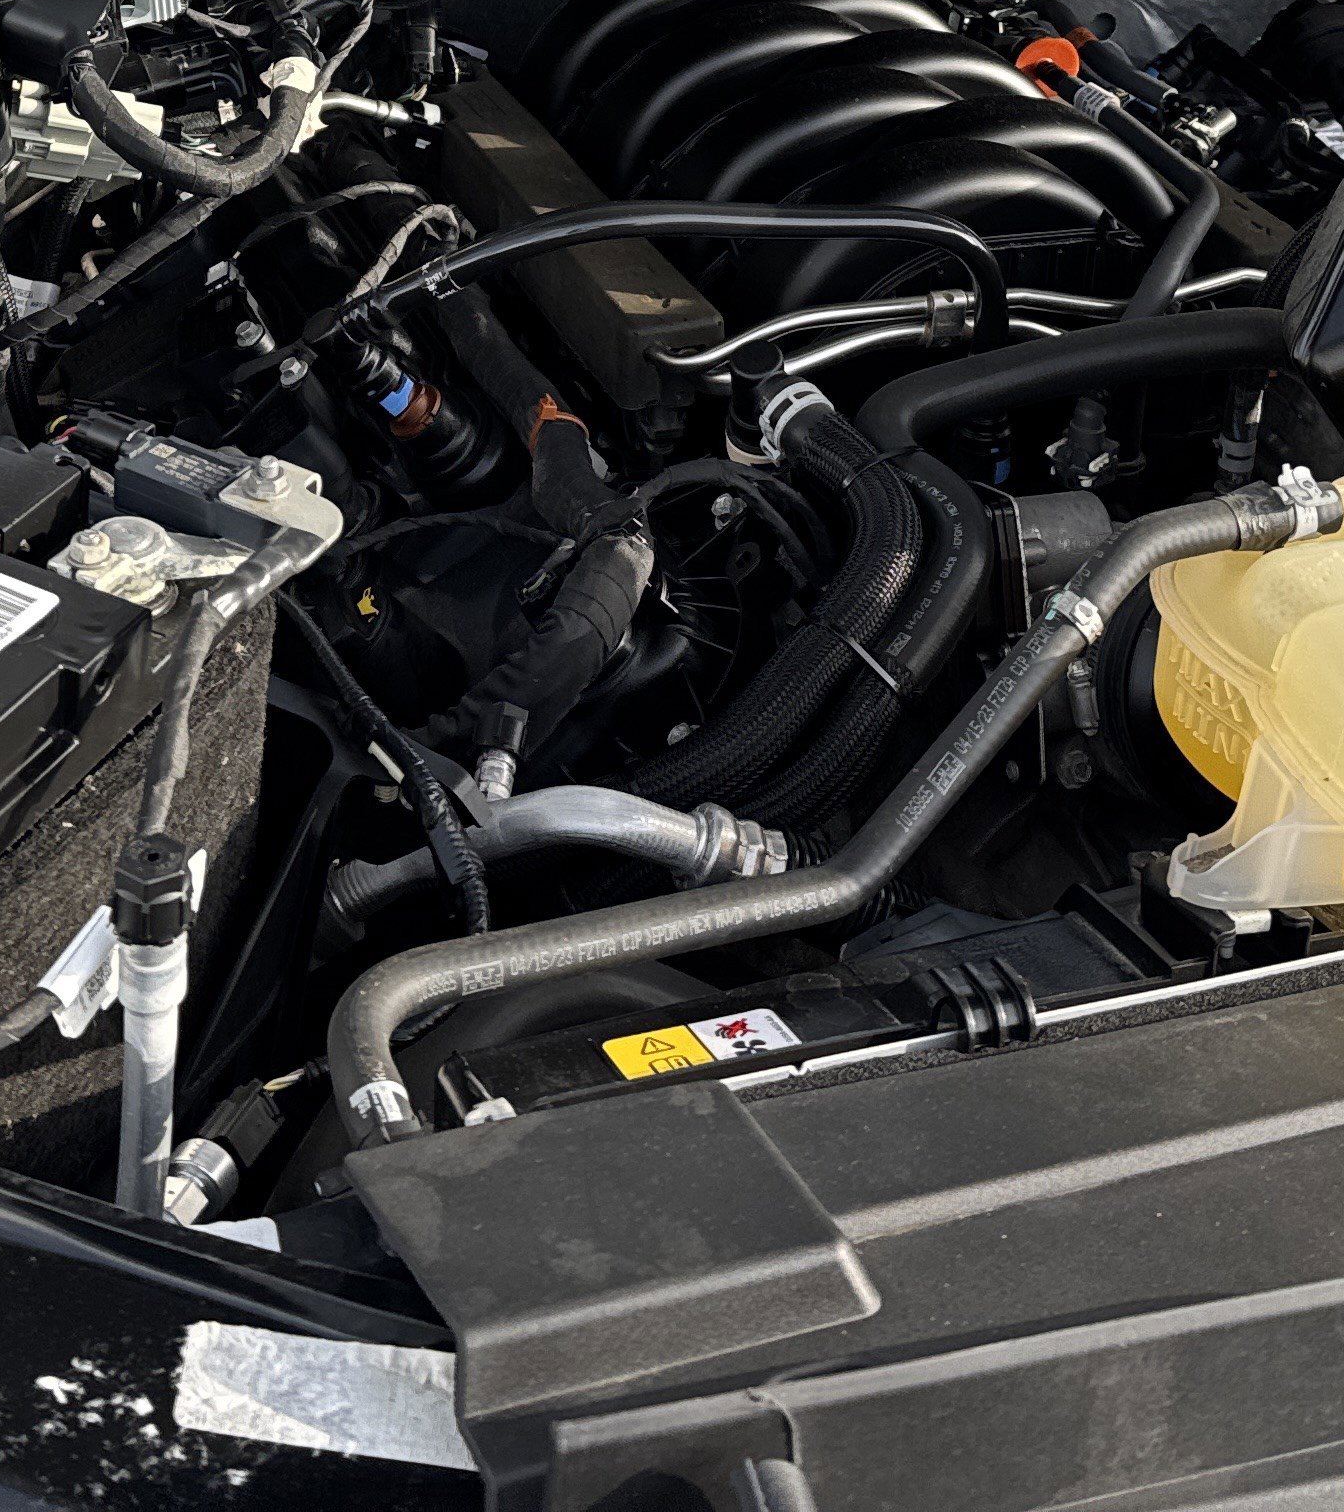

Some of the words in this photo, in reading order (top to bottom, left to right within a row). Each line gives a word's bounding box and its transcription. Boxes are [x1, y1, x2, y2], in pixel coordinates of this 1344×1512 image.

[1177, 647, 1246, 724] MAX
[954, 704, 995, 755] 04/15/23
[1171, 686, 1246, 766] MIN
